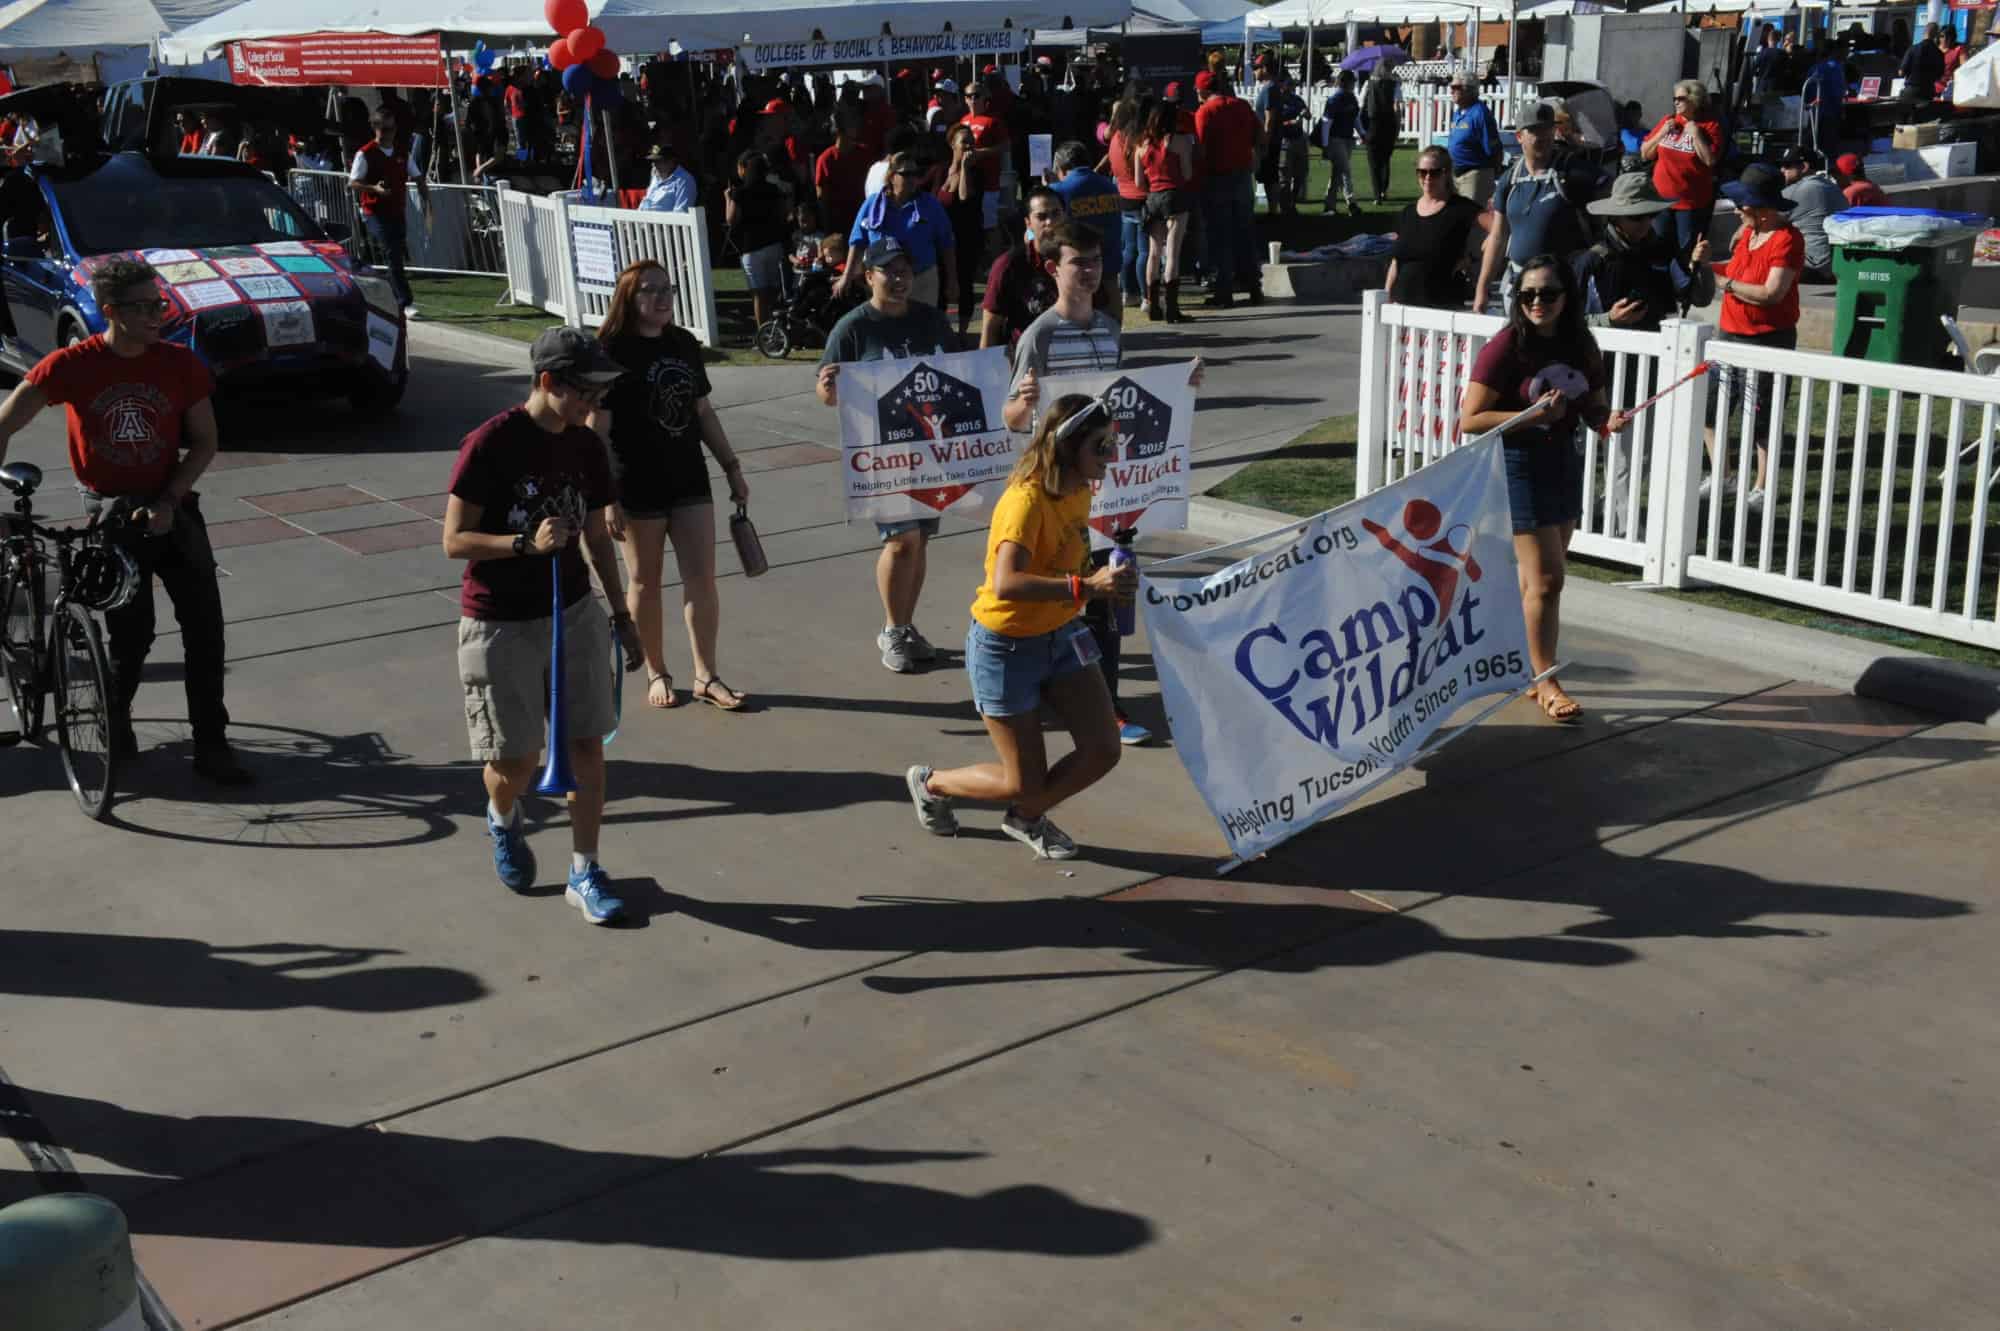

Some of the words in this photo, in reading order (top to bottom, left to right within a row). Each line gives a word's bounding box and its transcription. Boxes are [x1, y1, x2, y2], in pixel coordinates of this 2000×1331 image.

[754, 44, 806, 64] COLLEGE
[812, 43, 826, 61] OF
[833, 42, 872, 59] SOCIAL
[878, 41, 885, 56] &
[891, 36, 957, 54] BEHAVIORAL
[961, 31, 1011, 51] SCIENCES
[1070, 194, 1120, 215] SECURIT
[914, 371, 939, 393] 50
[1107, 386, 1138, 409] 50
[112, 407, 151, 442] A
[955, 421, 981, 433] 2015
[850, 448, 924, 473] Camp
[929, 437, 1013, 464] Wildcat
[1138, 441, 1165, 455] 2015
[852, 478, 892, 491] Helping
[921, 472, 943, 483] Feet
[1235, 583, 1436, 701] Camp
[1271, 586, 1485, 751] Wildcat
[1221, 794, 1295, 841] Helping
[1299, 752, 1379, 804] Tucson
[1369, 712, 1415, 761] Youth
[1414, 677, 1458, 723] Since
[1463, 650, 1523, 687] 1965
